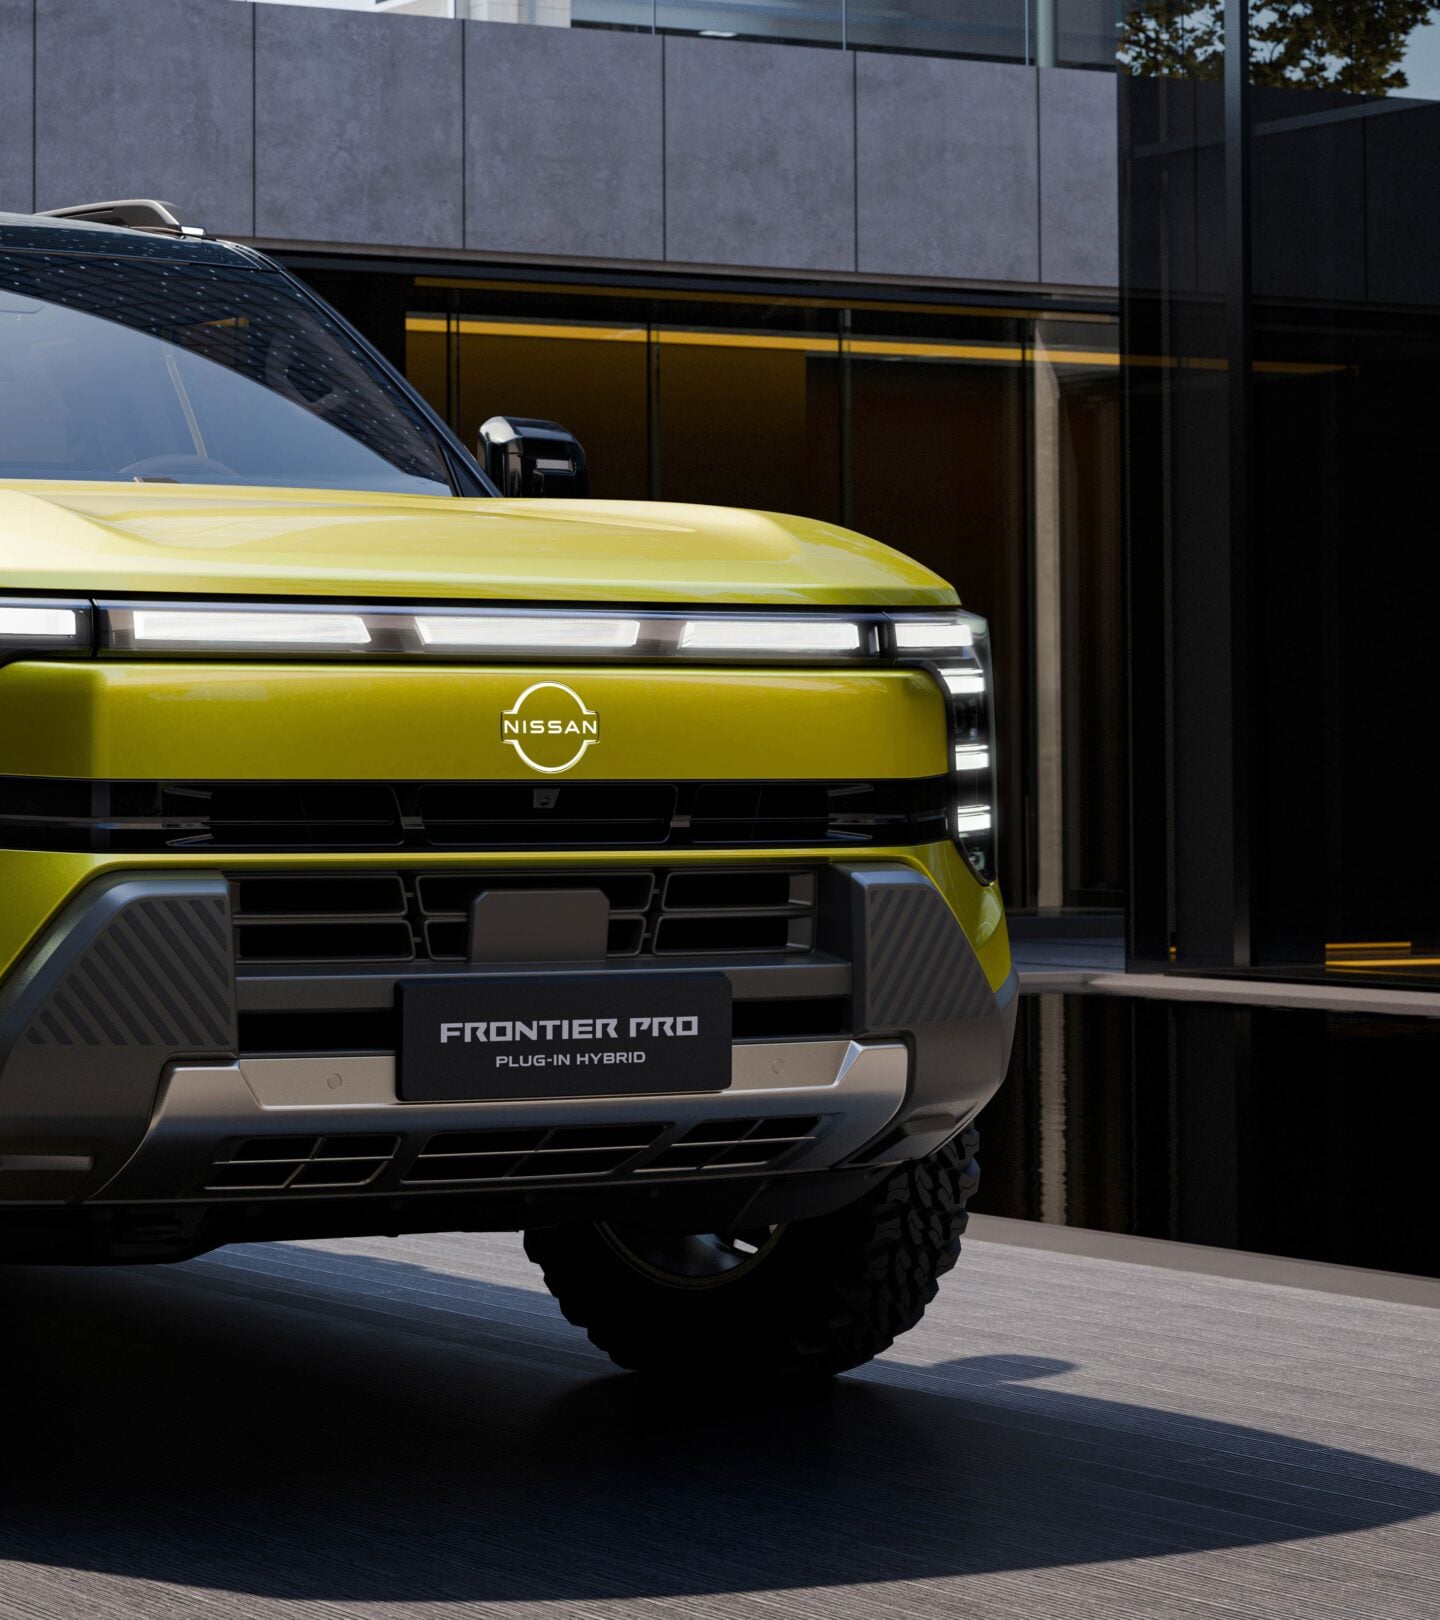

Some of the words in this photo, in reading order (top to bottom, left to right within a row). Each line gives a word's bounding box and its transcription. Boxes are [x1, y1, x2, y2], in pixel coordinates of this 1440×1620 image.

[504, 719, 597, 735] NISSAN
[440, 1018, 618, 1044] FRONTIER
[629, 1015, 699, 1038] PRO
[495, 1053, 571, 1068] PLUG-IN
[576, 1051, 646, 1065] HYBRID
